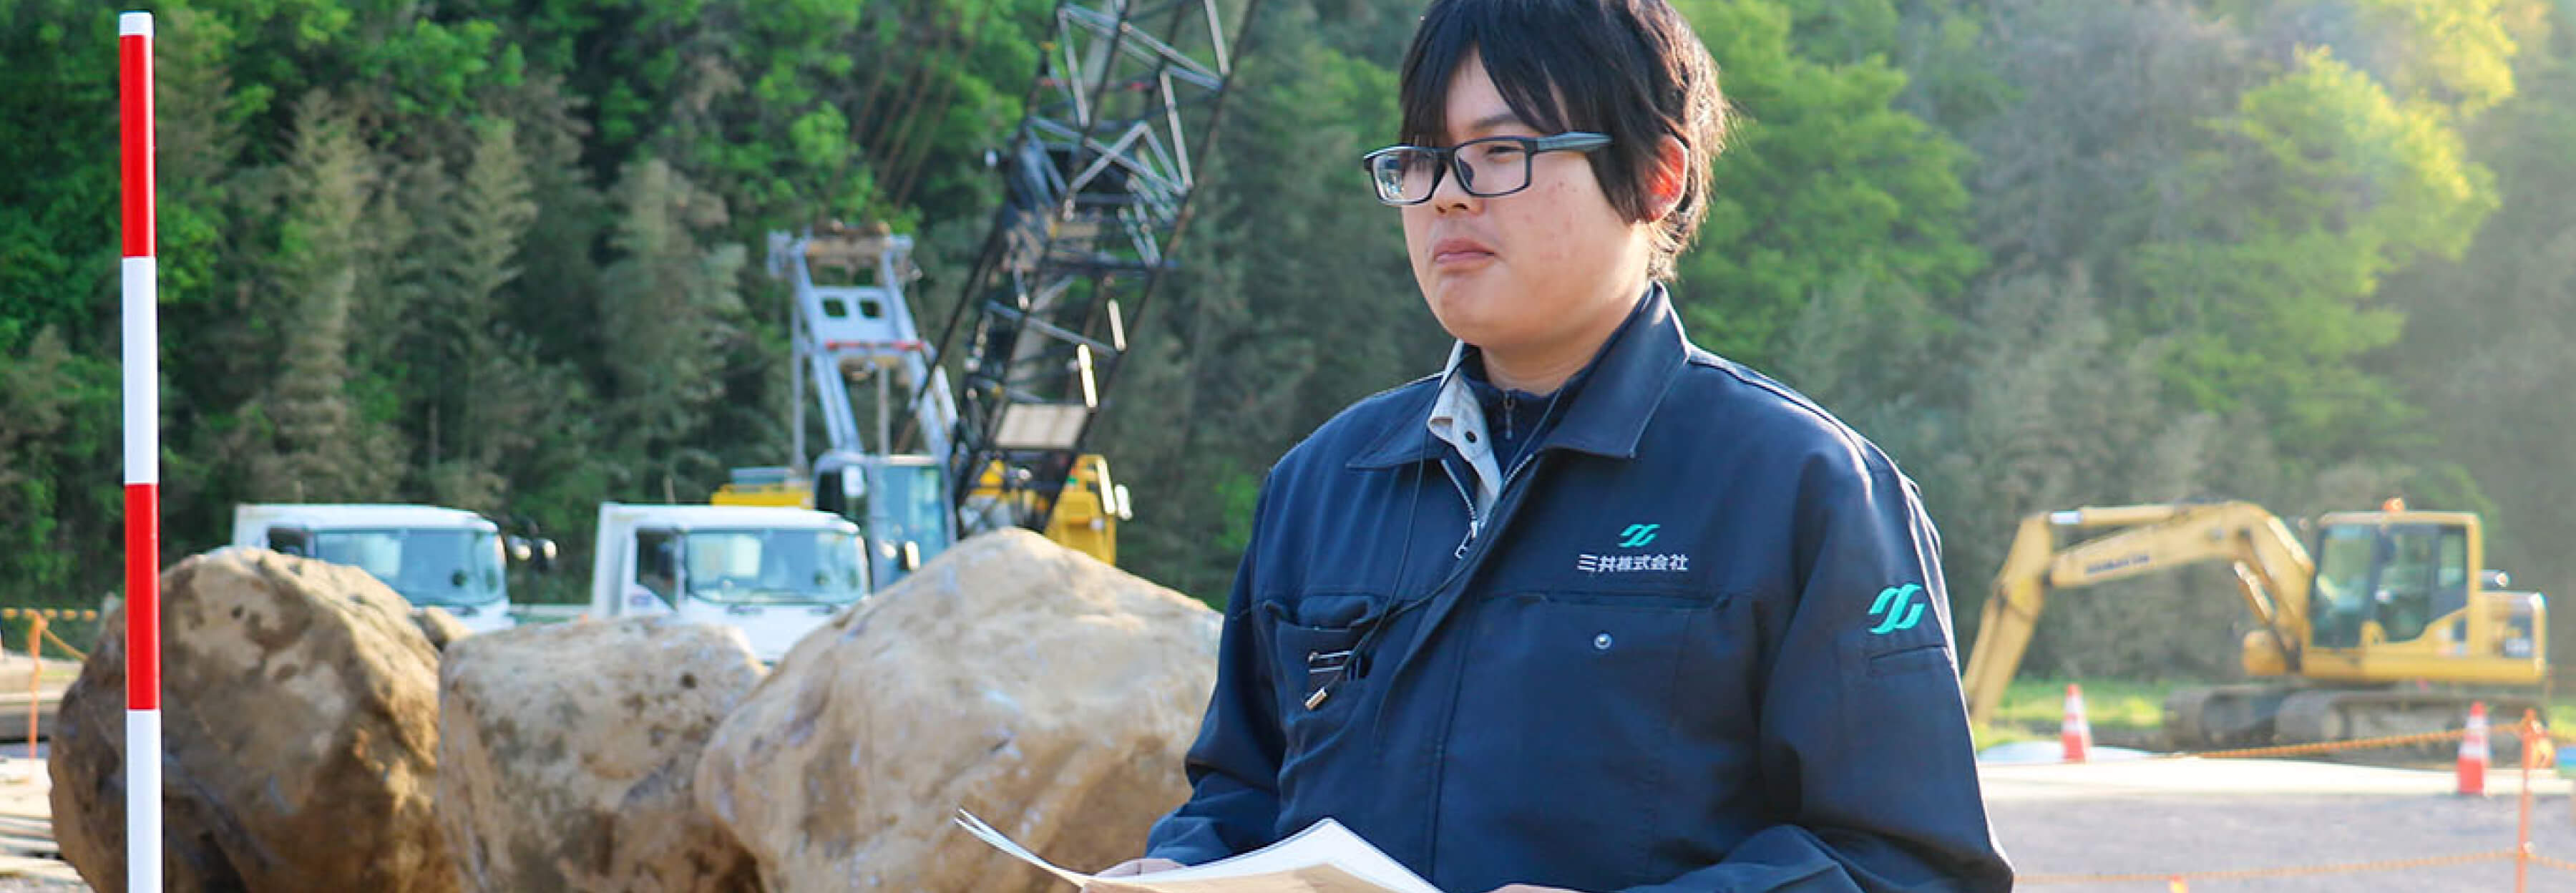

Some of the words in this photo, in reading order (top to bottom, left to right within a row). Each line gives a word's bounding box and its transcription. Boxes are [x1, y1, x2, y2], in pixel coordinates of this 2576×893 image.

[1577, 554, 1689, 572] 三井株式会社
